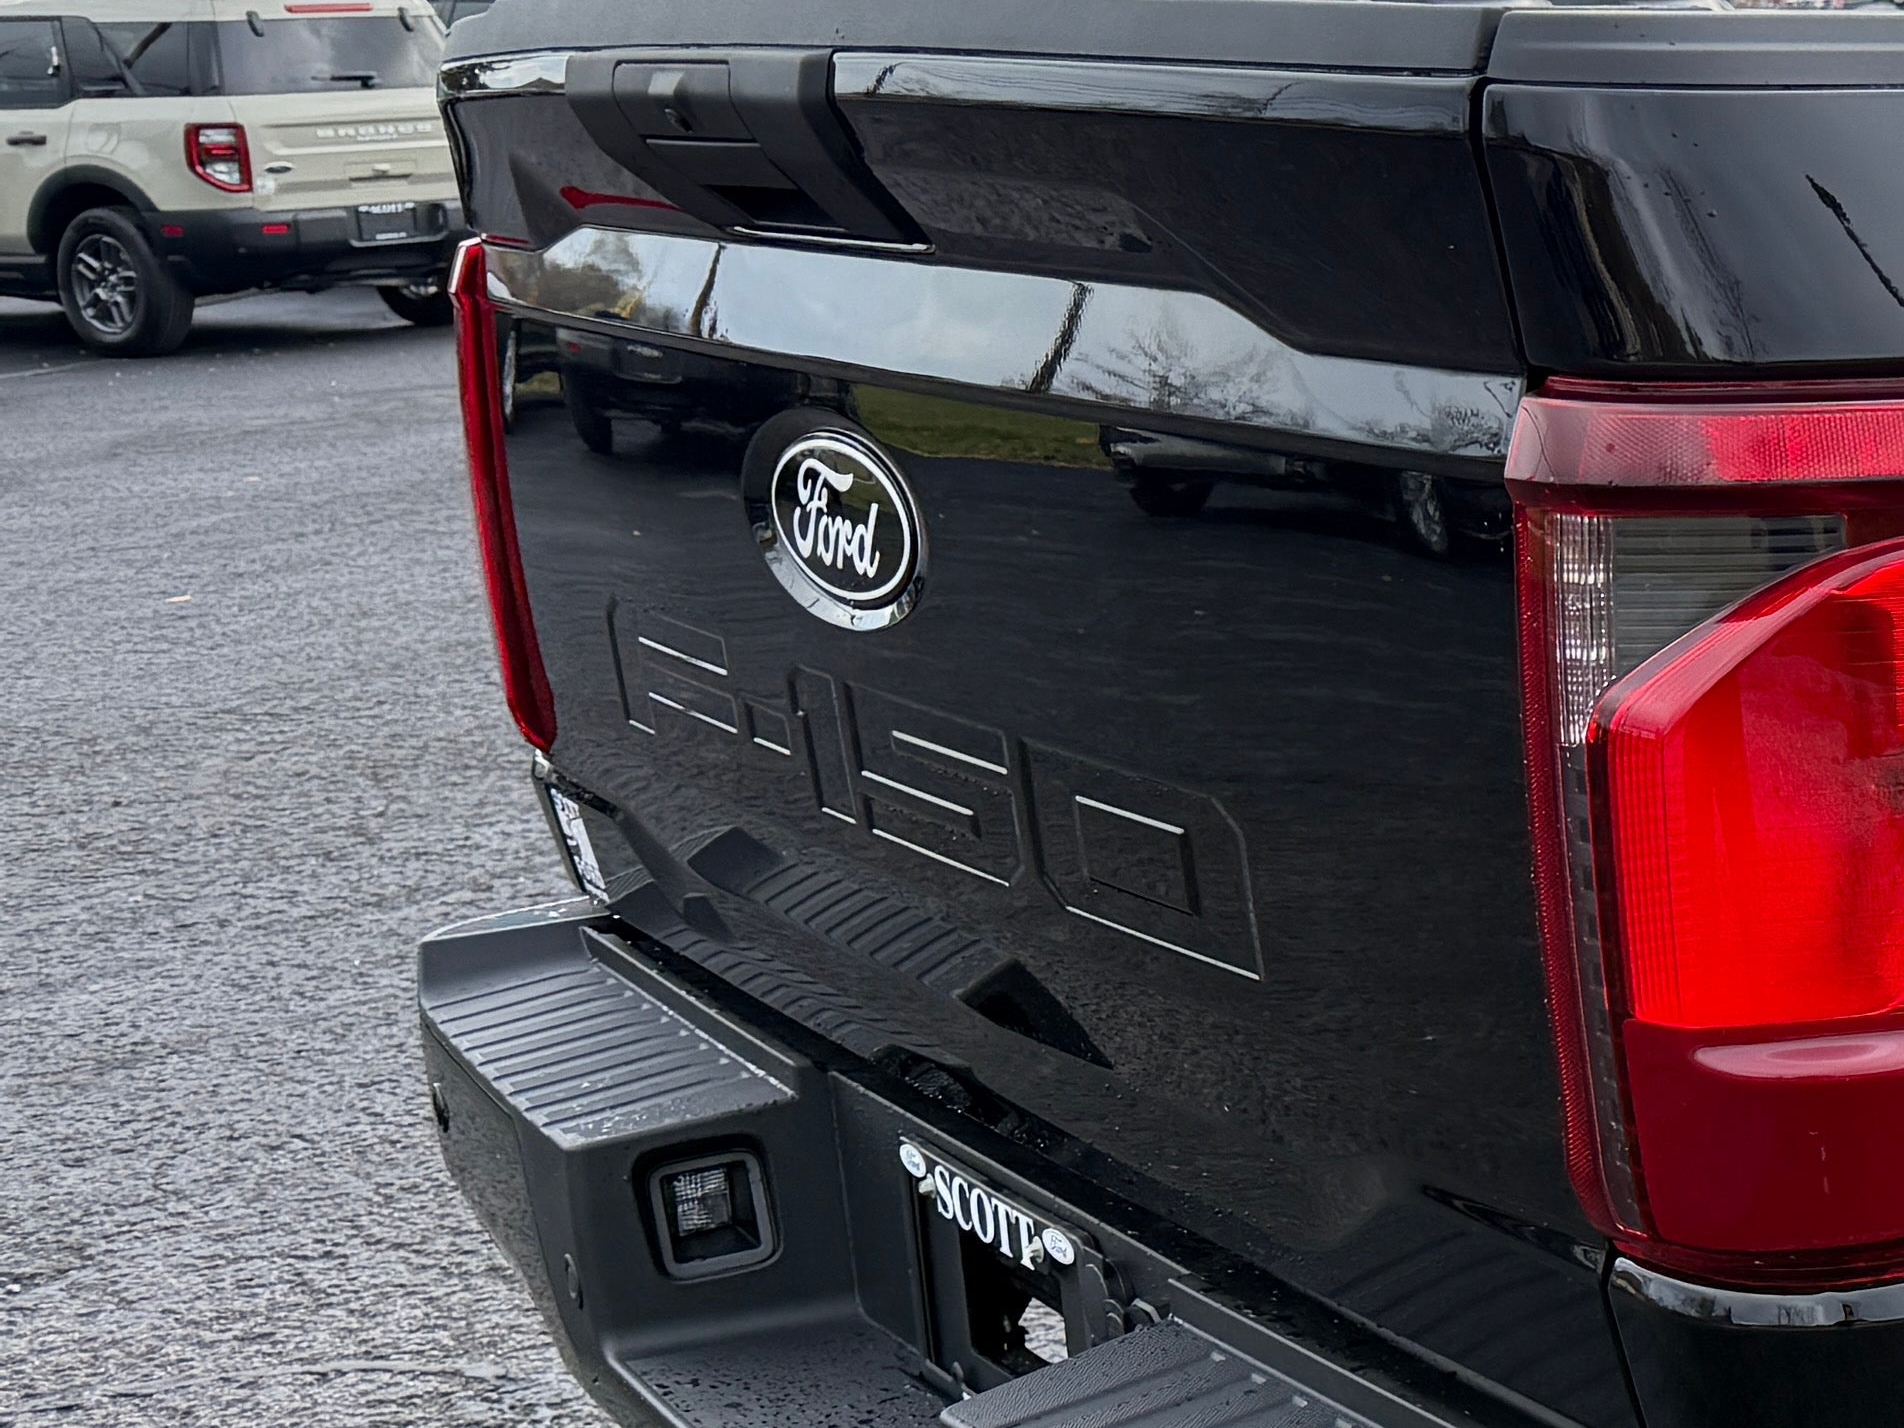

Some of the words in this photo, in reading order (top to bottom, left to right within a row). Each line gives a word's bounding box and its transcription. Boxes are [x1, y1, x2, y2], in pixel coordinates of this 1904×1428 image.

[794, 458, 880, 578] Ford
[606, 596, 1264, 982] F-150
[934, 1165, 1036, 1271] SCOTT
